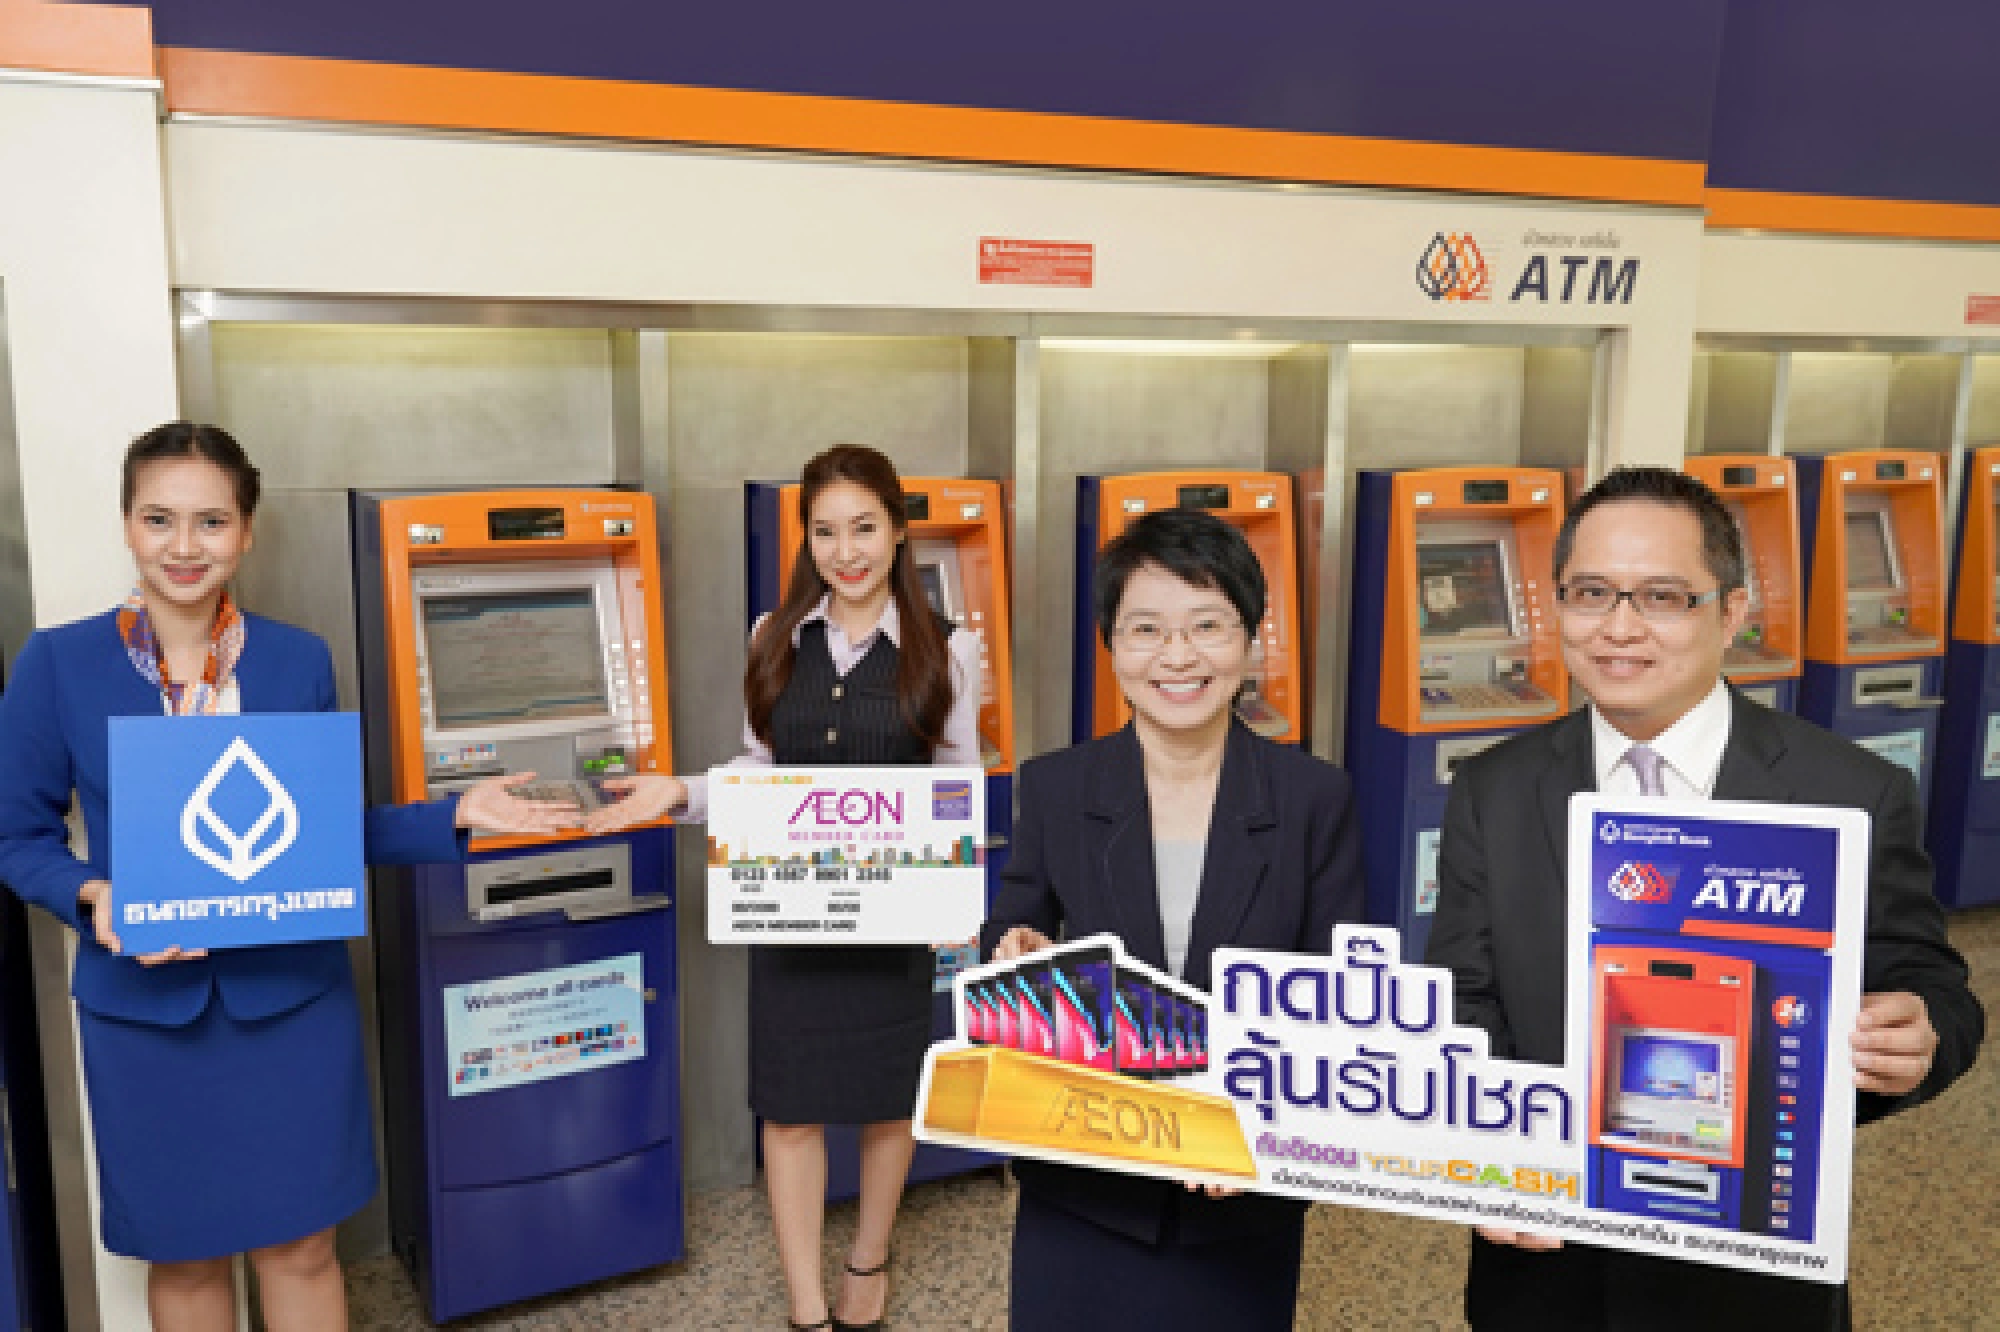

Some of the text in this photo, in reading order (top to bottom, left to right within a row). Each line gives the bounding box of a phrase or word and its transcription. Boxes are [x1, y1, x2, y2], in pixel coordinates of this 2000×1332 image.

[1508, 254, 1640, 304] ATM
[1691, 879, 1807, 916] ATM
[464, 987, 548, 1012] Welcome
[1223, 1028, 1574, 1142] ลุ้นรับโชค
